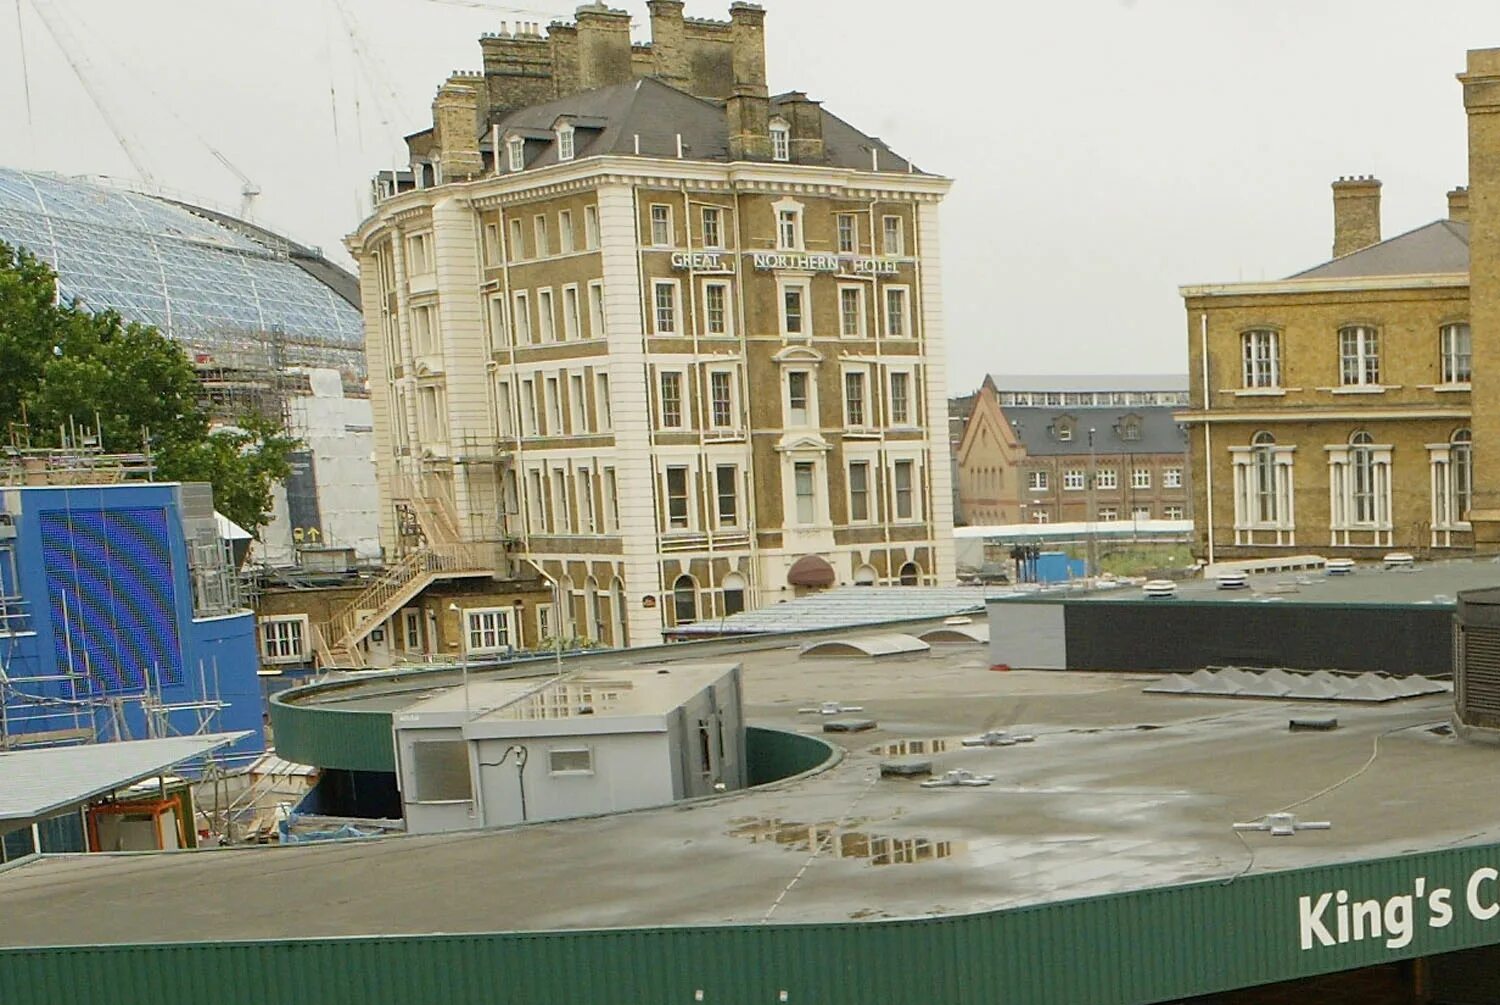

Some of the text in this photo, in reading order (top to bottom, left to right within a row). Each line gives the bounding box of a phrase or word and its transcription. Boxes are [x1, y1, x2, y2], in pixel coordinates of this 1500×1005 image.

[671, 253, 900, 273] GREAT NORTHERN HOTEL
[1299, 877, 1453, 950] King's
